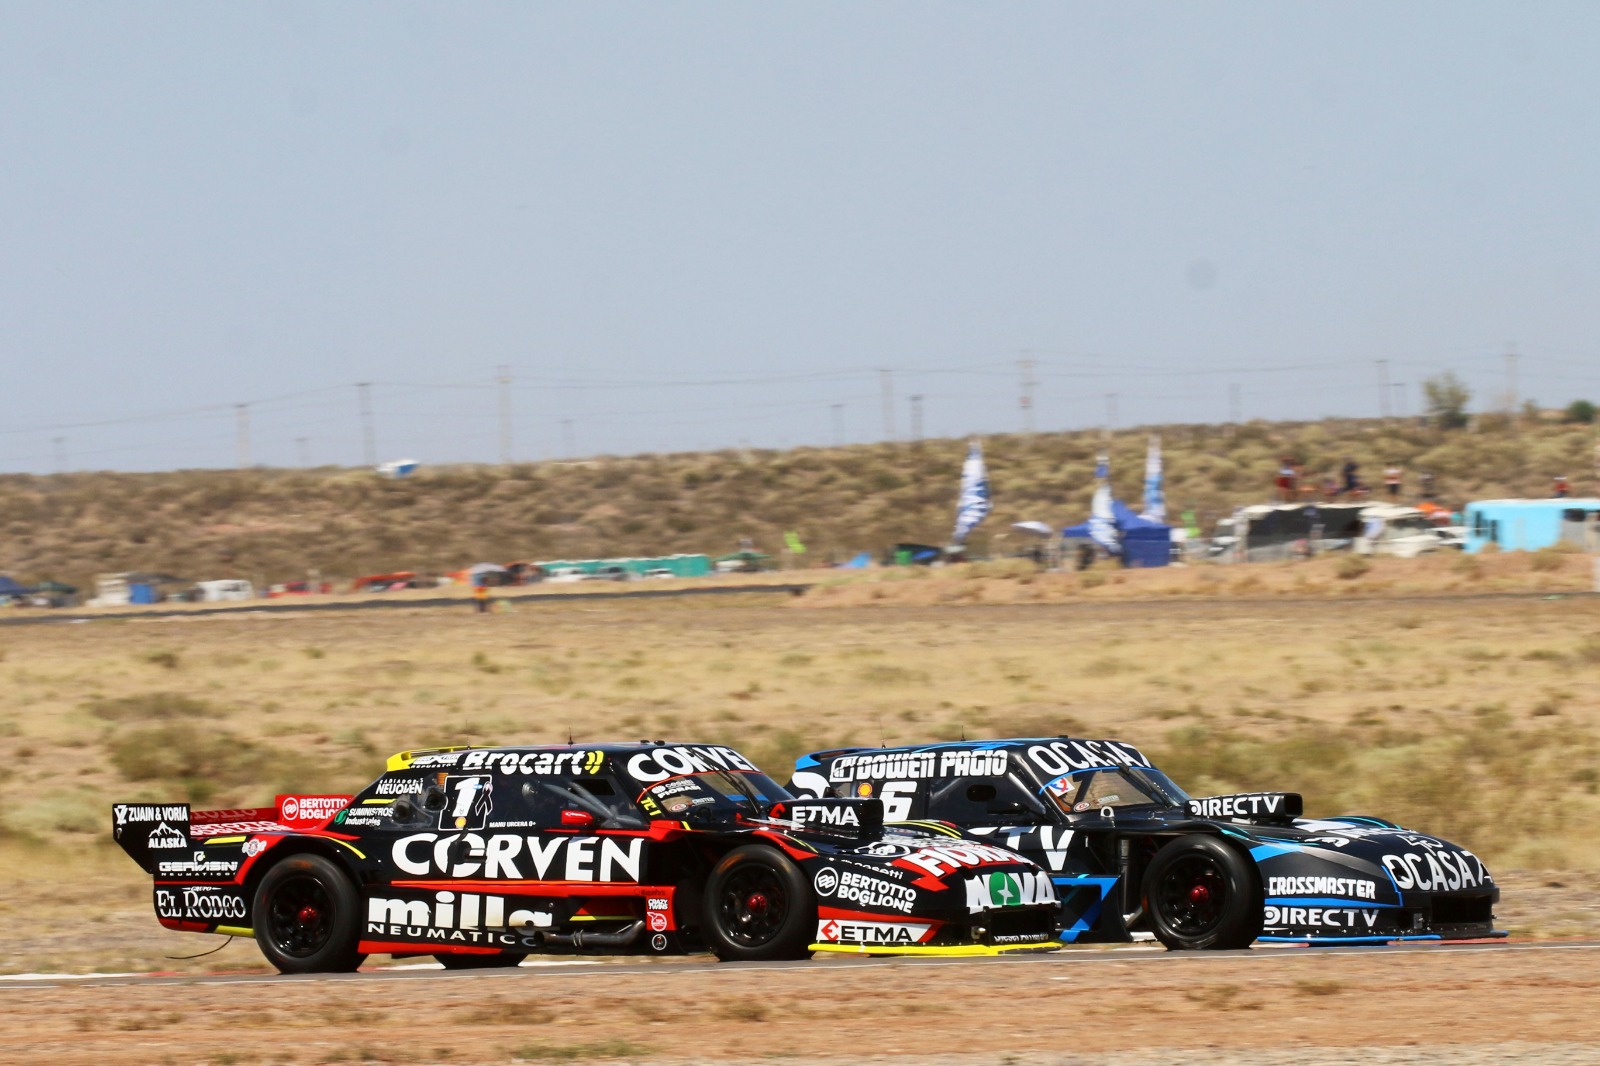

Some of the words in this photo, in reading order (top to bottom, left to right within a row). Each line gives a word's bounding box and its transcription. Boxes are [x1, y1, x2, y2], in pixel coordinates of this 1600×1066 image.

[463, 751, 586, 775] Brocart
[627, 747, 760, 782] CORVE
[452, 777, 480, 818] 1
[879, 781, 918, 822] 6
[1188, 796, 1281, 817] DIRECTV
[128, 806, 155, 822] ZUAIN
[155, 807, 161, 821] &
[162, 806, 188, 822] VORIA
[792, 806, 860, 827] ETMA
[148, 837, 187, 849] ALASKA
[391, 832, 645, 884] CORVEN
[840, 871, 917, 902] BERTOTTO
[1268, 876, 1376, 900] CROSSMASTER
[368, 890, 553, 930] milla
[837, 884, 915, 914] BOGLIONE
[1263, 905, 1380, 927] DIRECTV
[841, 925, 913, 942] ETMA
